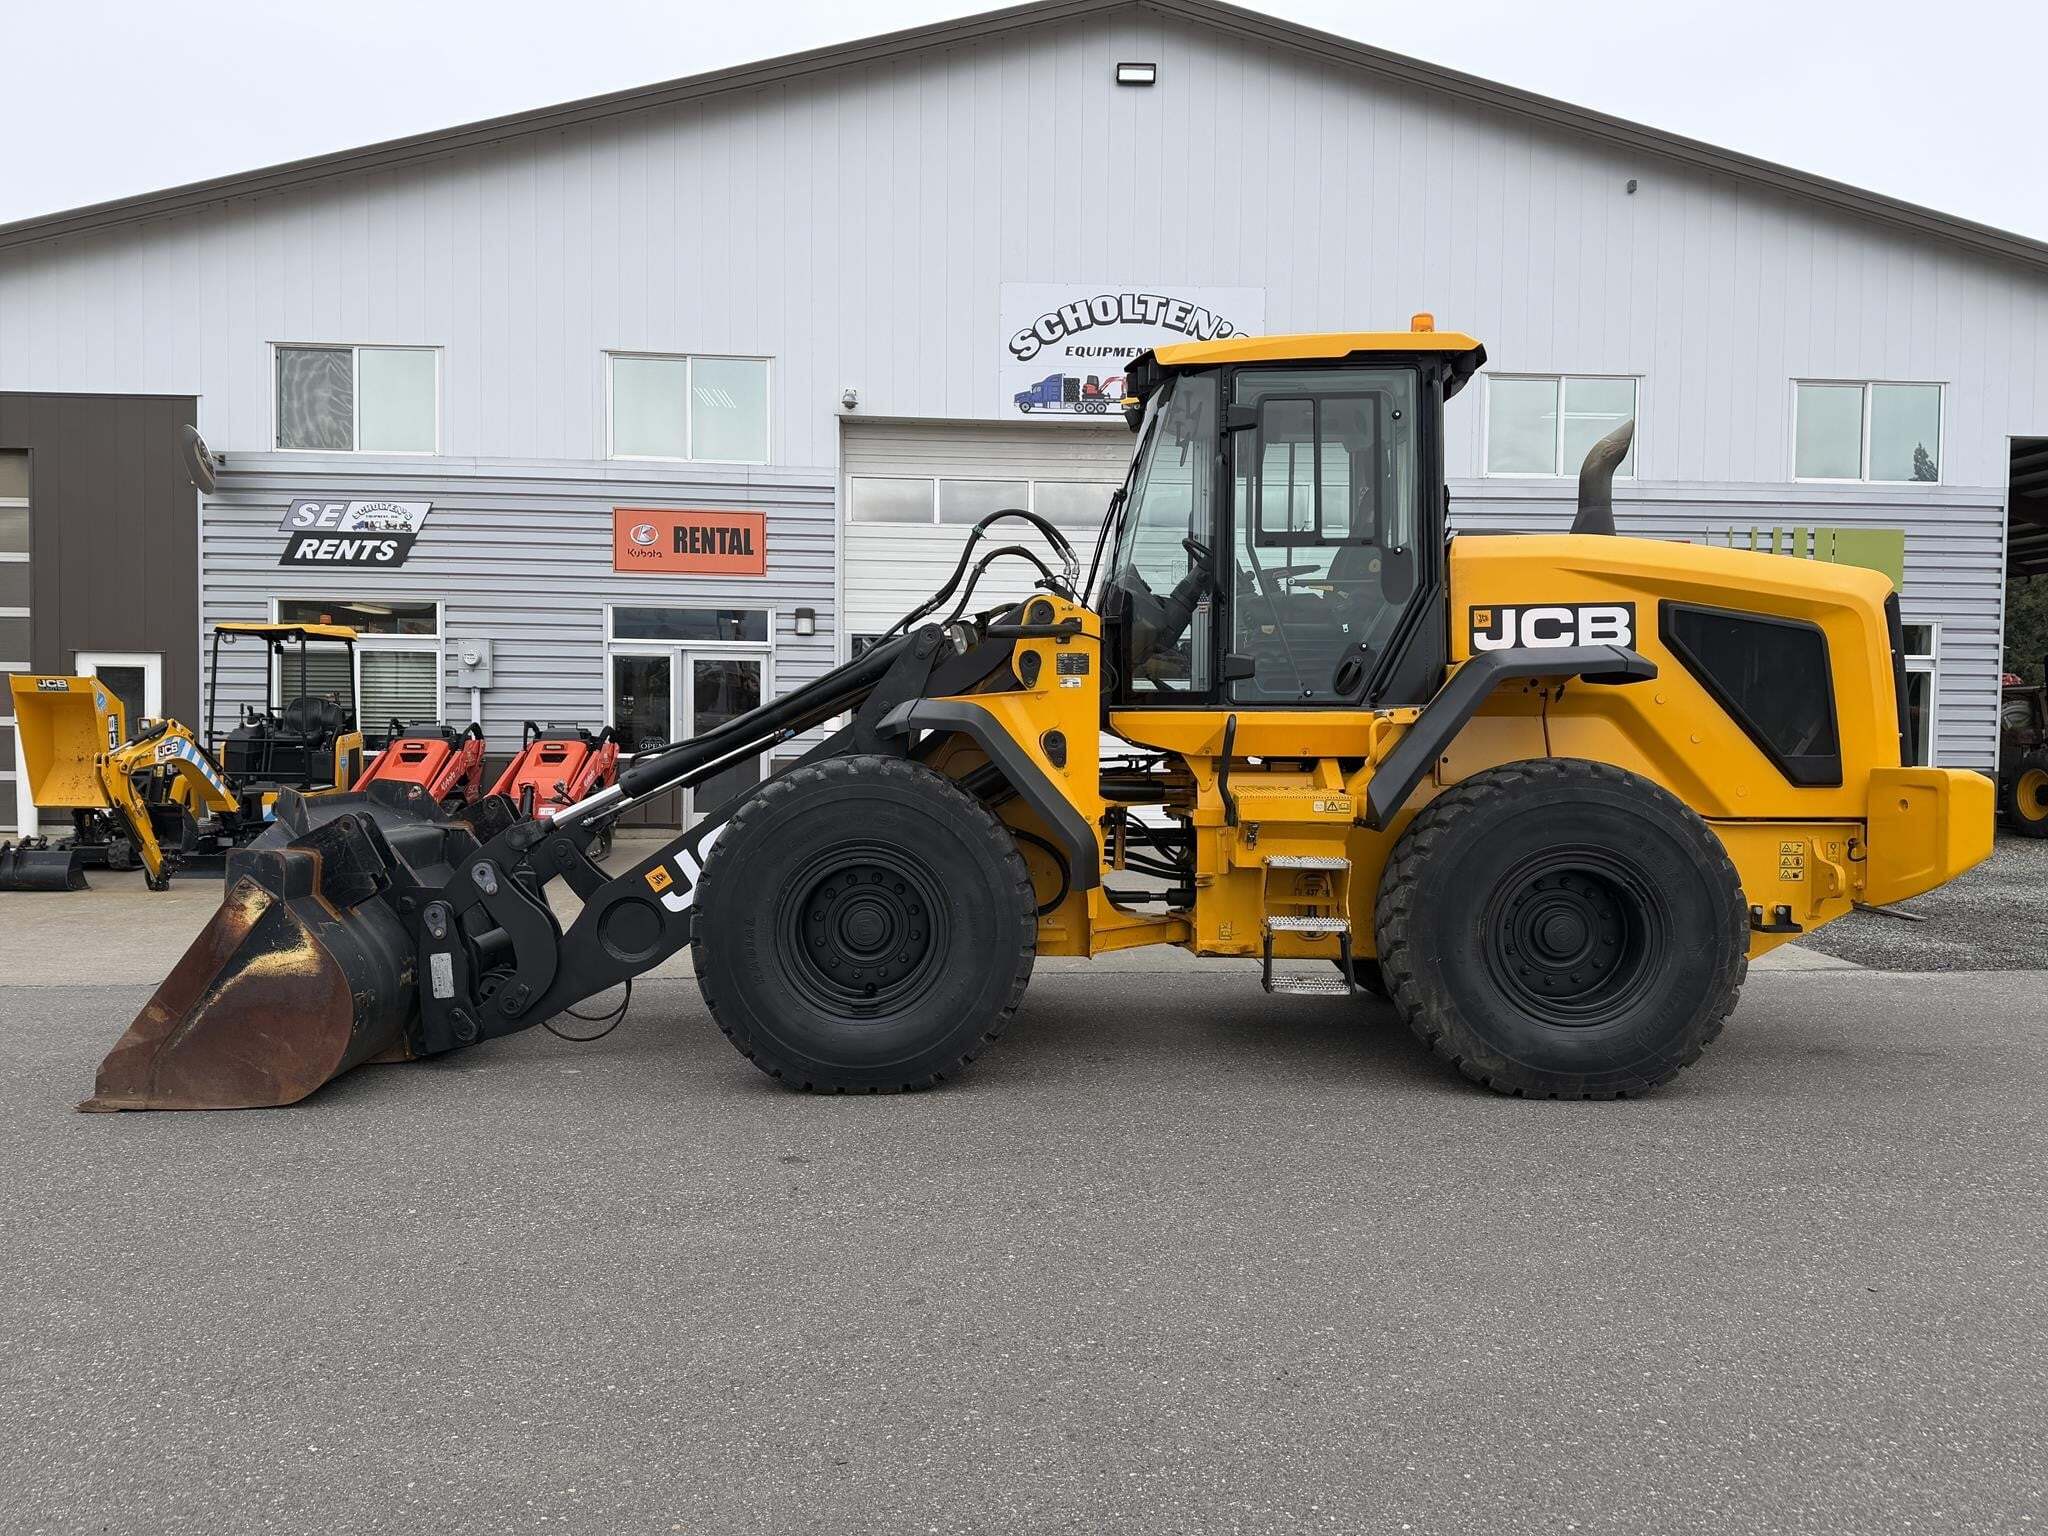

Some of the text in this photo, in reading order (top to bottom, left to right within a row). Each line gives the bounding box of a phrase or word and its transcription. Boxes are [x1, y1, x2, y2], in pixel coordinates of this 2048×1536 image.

[1009, 293, 1250, 361] SCHOLTEN'
[1065, 345, 1153, 358] EQUIPMEN
[292, 503, 345, 527] SE
[294, 538, 398, 561] RENTS
[673, 526, 754, 555] RENTAL
[627, 548, 662, 558] Kubota
[1473, 606, 1632, 651] JCB
[38, 679, 68, 688] JCB
[158, 743, 178, 756] JCB
